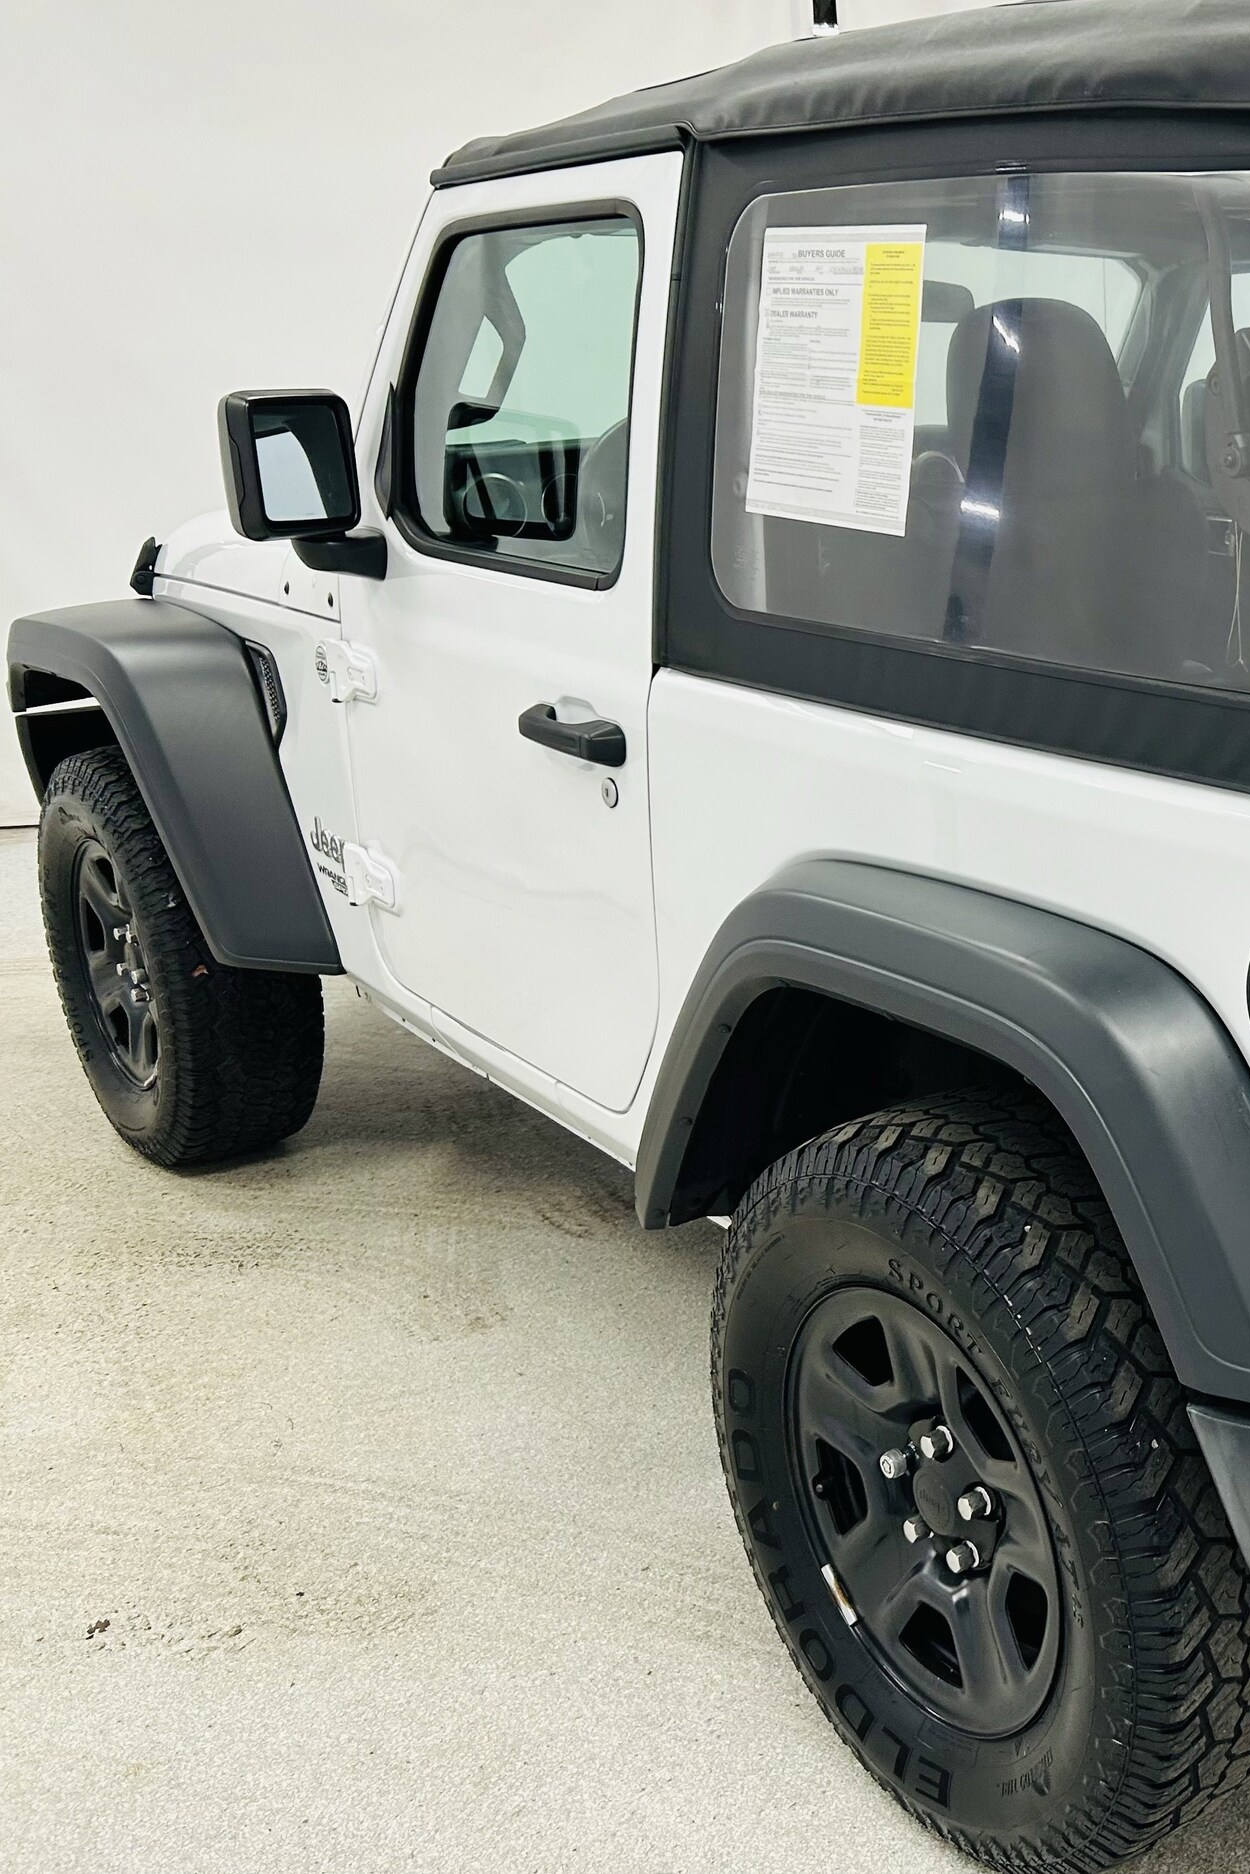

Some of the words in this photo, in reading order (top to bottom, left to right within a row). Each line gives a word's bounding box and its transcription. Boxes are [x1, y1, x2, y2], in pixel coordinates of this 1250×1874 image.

[798, 249, 824, 258] BUYERS
[825, 249, 846, 258] GUIDE
[791, 288, 824, 296] WARRANTIES
[825, 288, 839, 297] ONLY
[770, 310, 789, 318] DEALER
[790, 311, 818, 319] WARRANTY
[886, 1257, 986, 1357] SPORT
[992, 1378, 1065, 1507] FURY
[728, 1367, 953, 1811] ELDORADO
